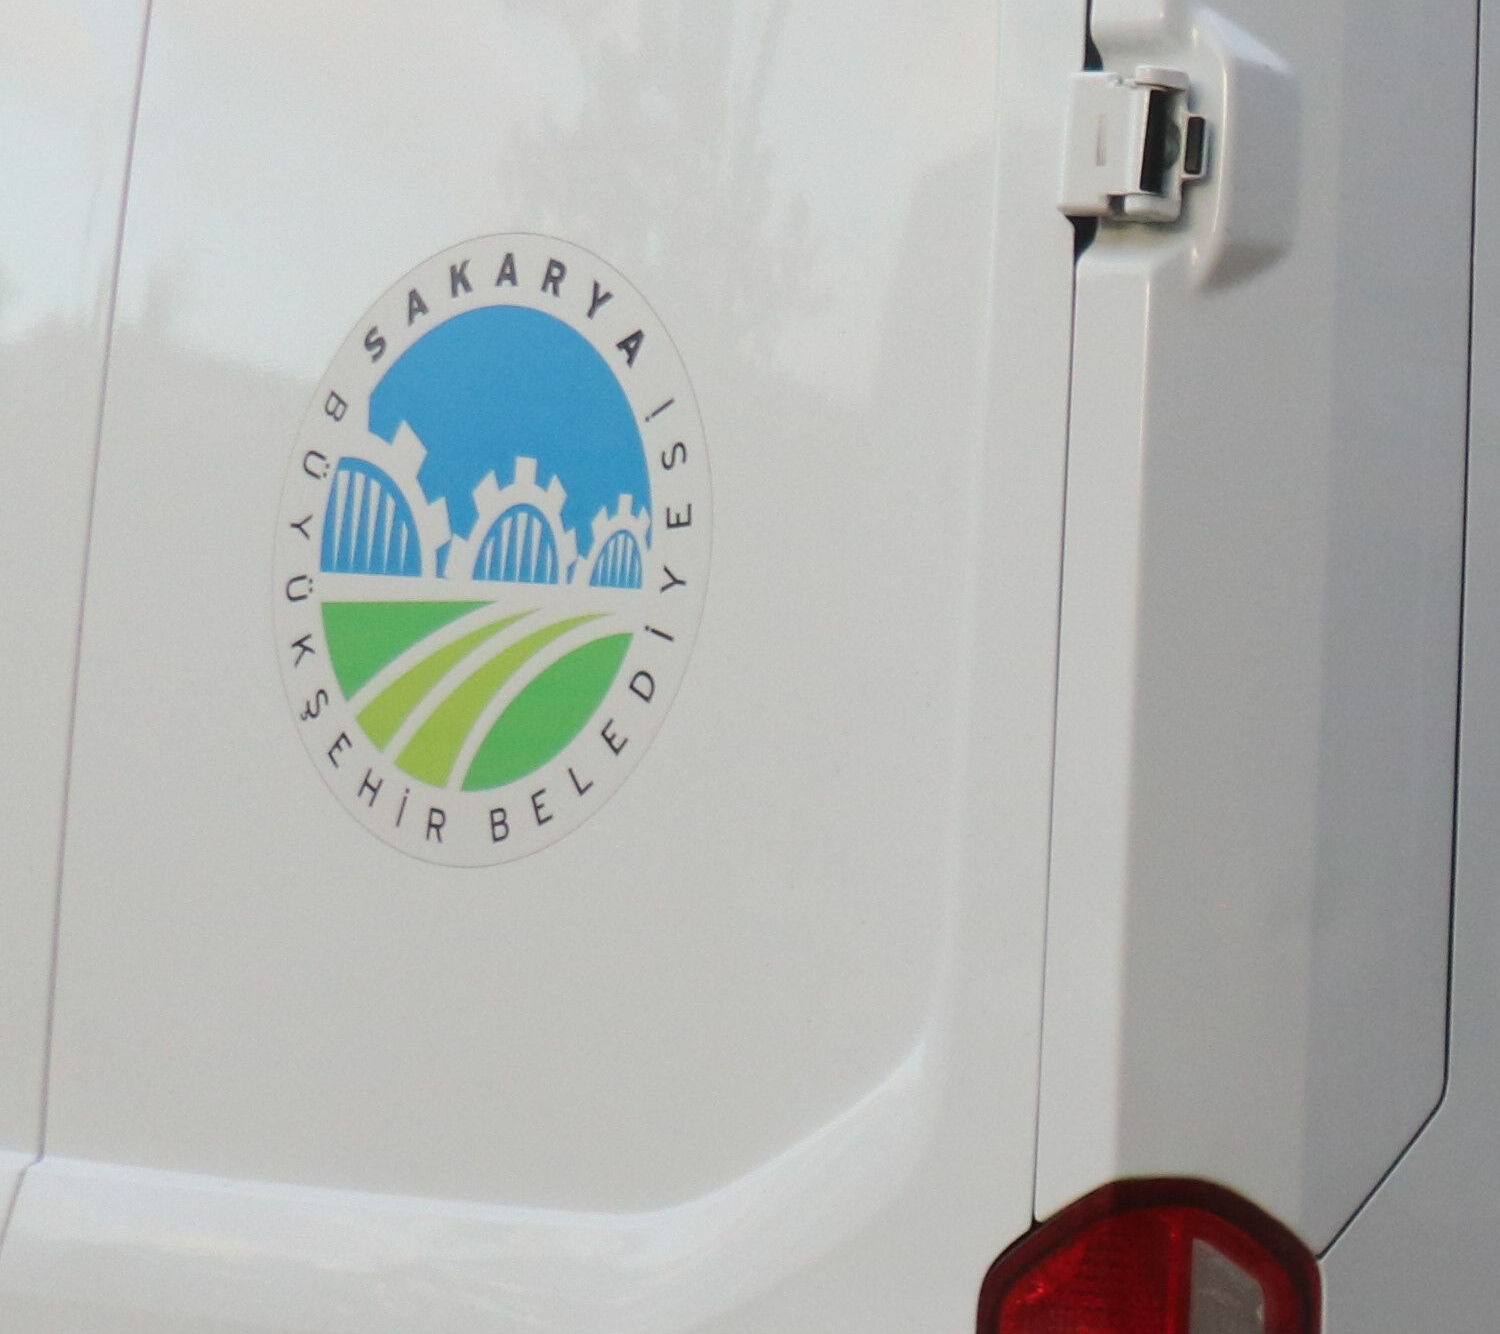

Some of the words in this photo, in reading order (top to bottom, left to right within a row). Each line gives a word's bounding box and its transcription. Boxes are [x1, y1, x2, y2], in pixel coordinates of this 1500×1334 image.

[362, 251, 646, 367] SAKARYA
[285, 390, 448, 845] BÜYÜKŞEHİR
[488, 397, 694, 844] BELEDİYESİ
